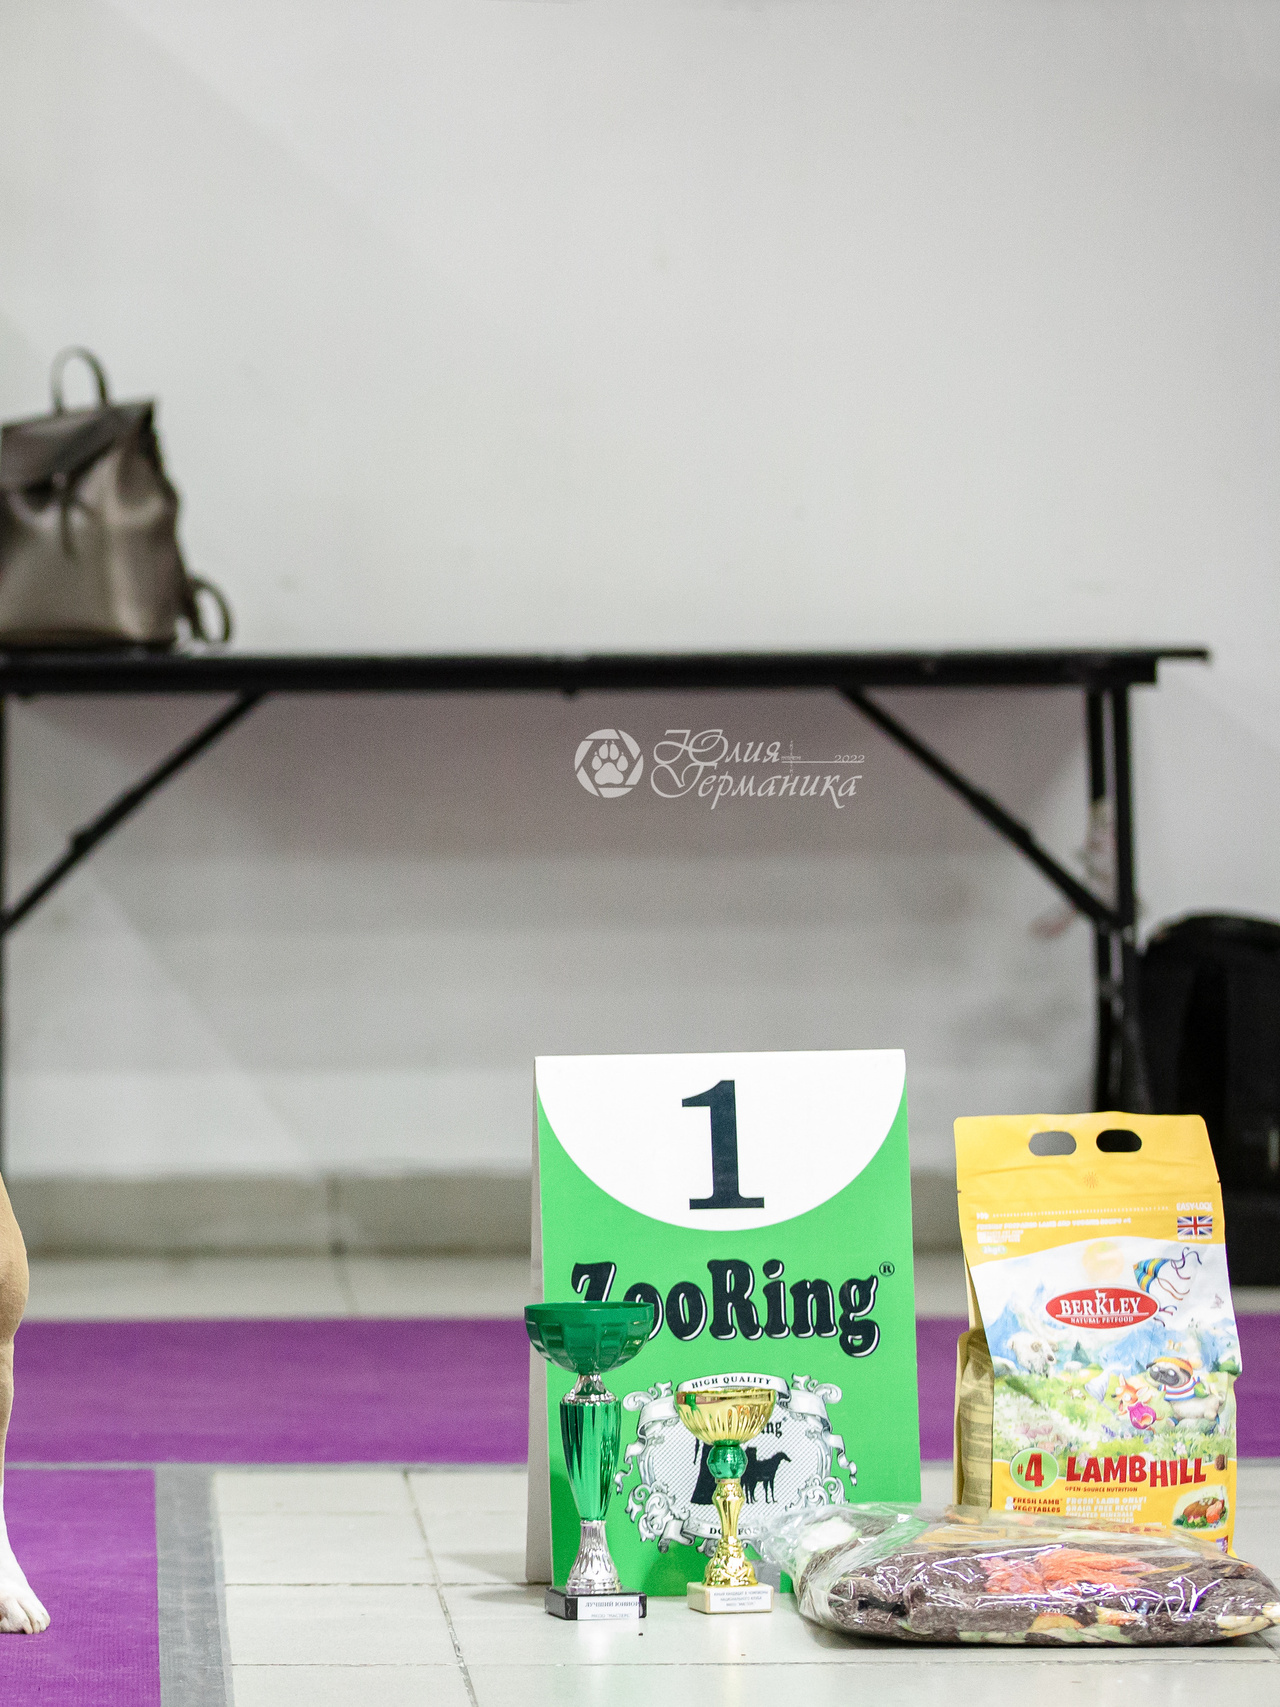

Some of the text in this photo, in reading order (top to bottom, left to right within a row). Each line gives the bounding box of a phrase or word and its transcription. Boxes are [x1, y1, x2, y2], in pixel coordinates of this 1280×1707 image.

[681, 1079, 765, 1210] 1
[1059, 1296, 1141, 1316] BERKLEY
[1070, 1316, 1134, 1325] NATURAL PETFOOD
[691, 1376, 772, 1389] HIGH QUALITY
[1017, 1453, 1045, 1488] #4
[1012, 1505, 1061, 1513] VEGETABLES
